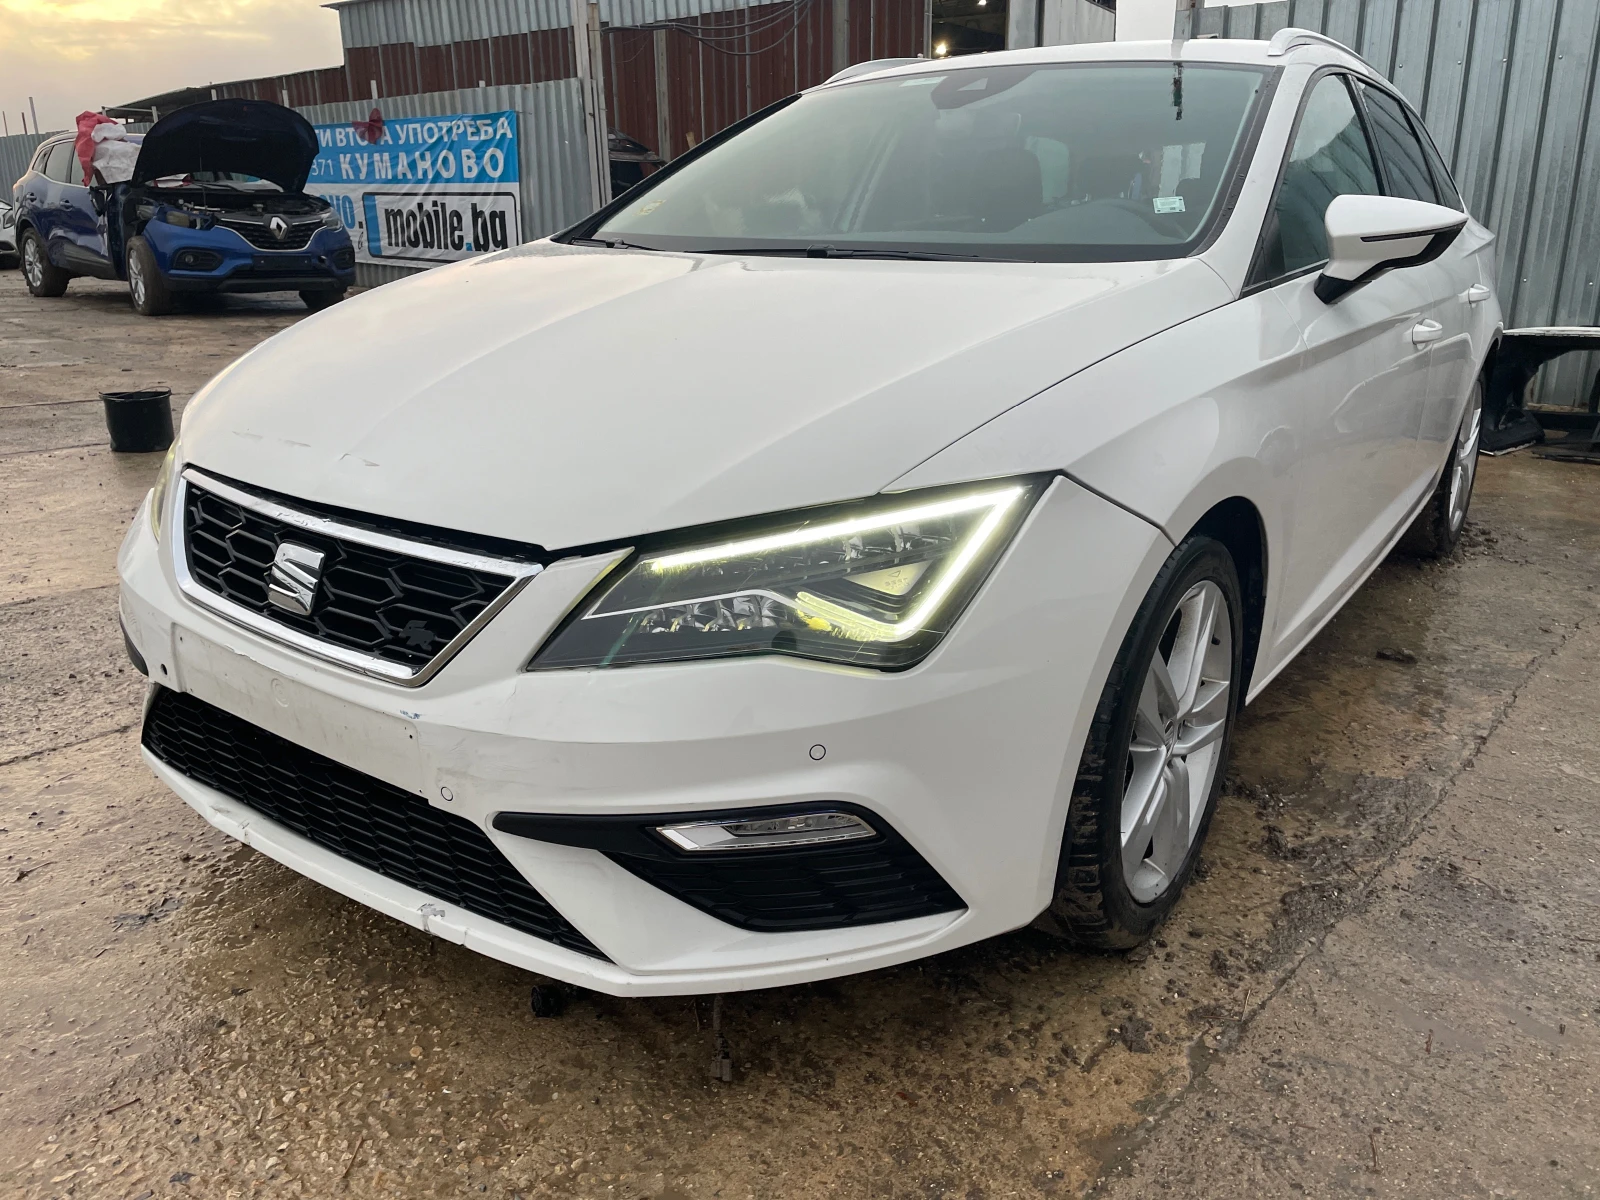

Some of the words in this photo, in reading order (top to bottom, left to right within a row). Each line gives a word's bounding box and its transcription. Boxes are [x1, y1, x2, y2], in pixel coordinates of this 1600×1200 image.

[335, 126, 393, 147] ВТОА
[395, 117, 513, 145] УПОТРЕБА
[339, 147, 504, 180] КУМАНОВО
[384, 200, 508, 253] mobile.bg
